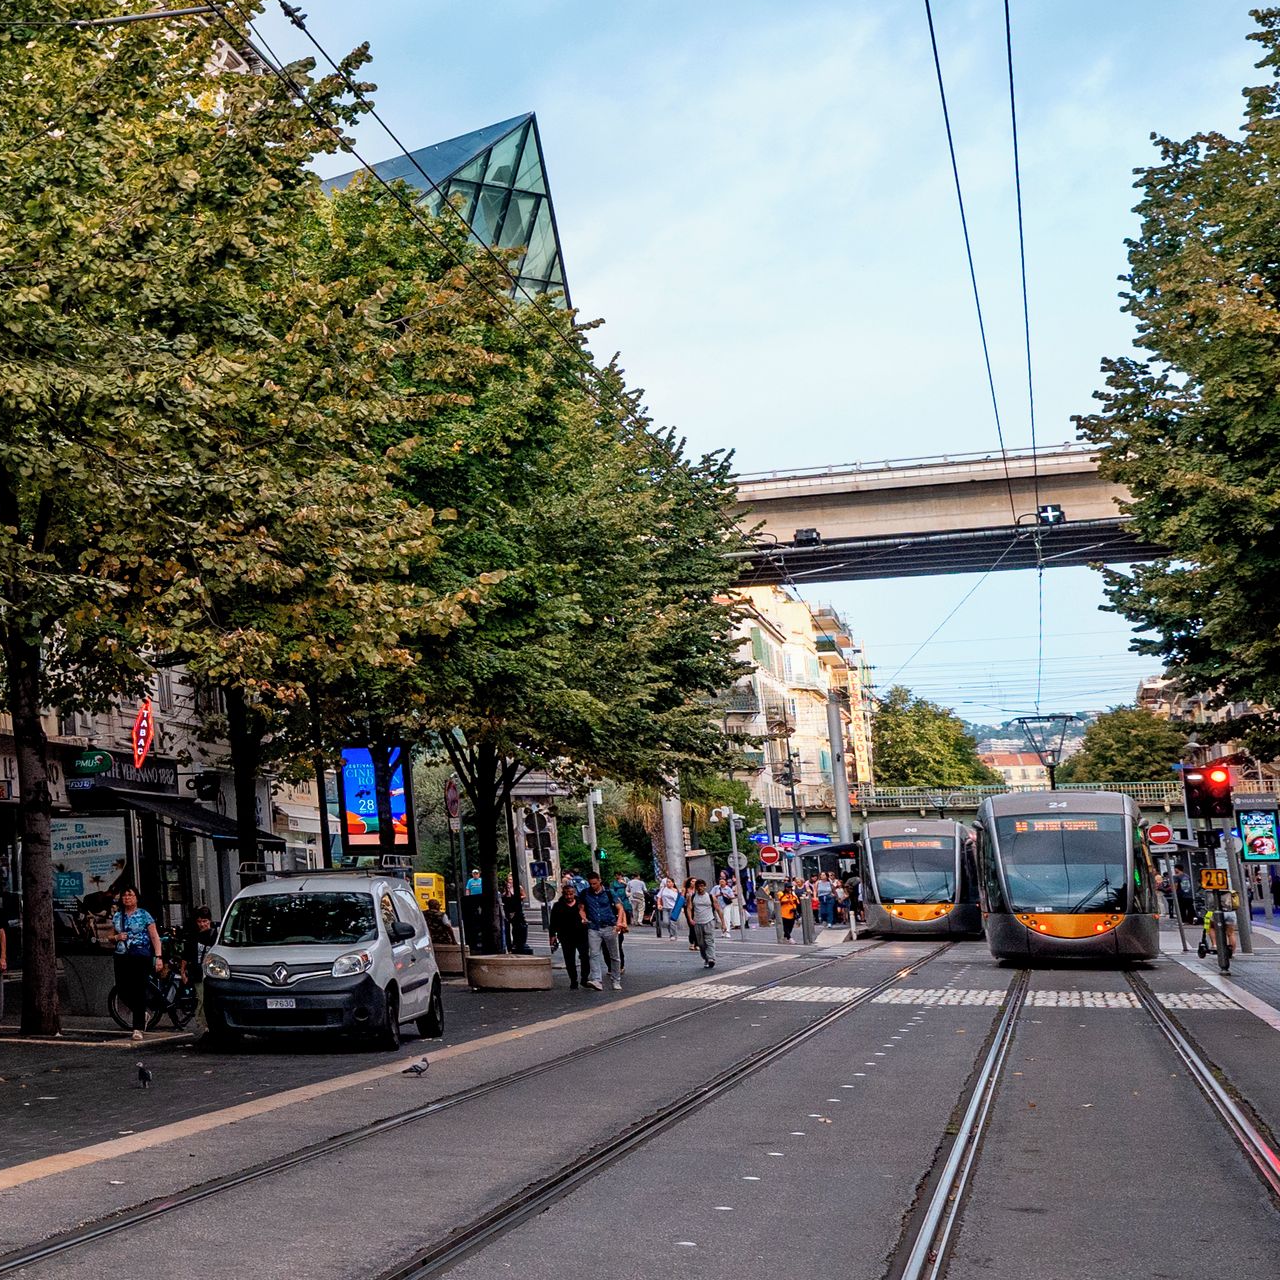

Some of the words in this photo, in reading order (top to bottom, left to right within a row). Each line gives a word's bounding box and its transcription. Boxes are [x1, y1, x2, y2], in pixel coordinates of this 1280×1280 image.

[137, 710, 148, 755] TABAC
[358, 799, 375, 811] 28
[1048, 801, 1068, 809] 24
[61, 833, 102, 841] STATIONNEMENT
[53, 841, 64, 850] 2h
[1205, 871, 1225, 887] 20
